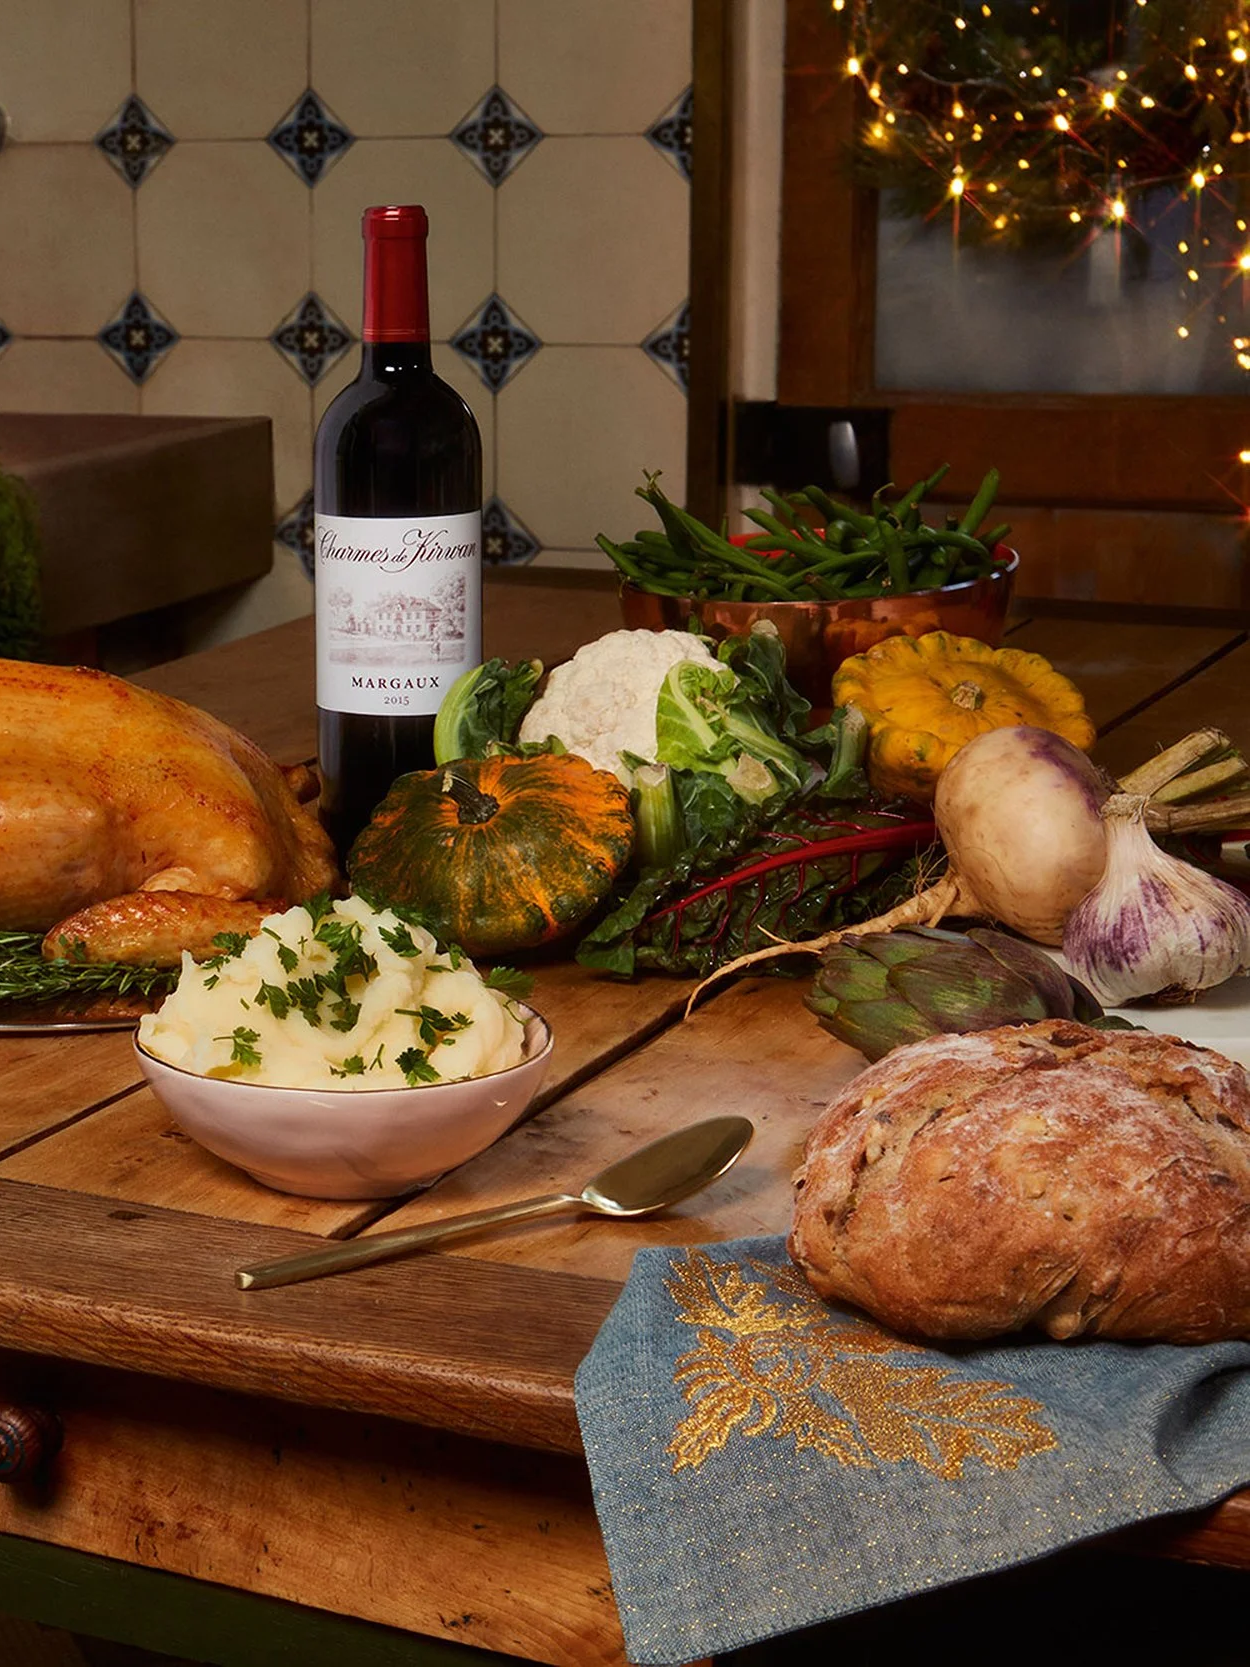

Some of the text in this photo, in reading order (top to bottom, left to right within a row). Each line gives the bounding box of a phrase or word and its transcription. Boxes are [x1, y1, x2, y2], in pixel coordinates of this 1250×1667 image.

[318, 526, 477, 573] Charmes de Kirwan
[351, 676, 440, 690] MARGAUX
[384, 696, 410, 706] 2015
